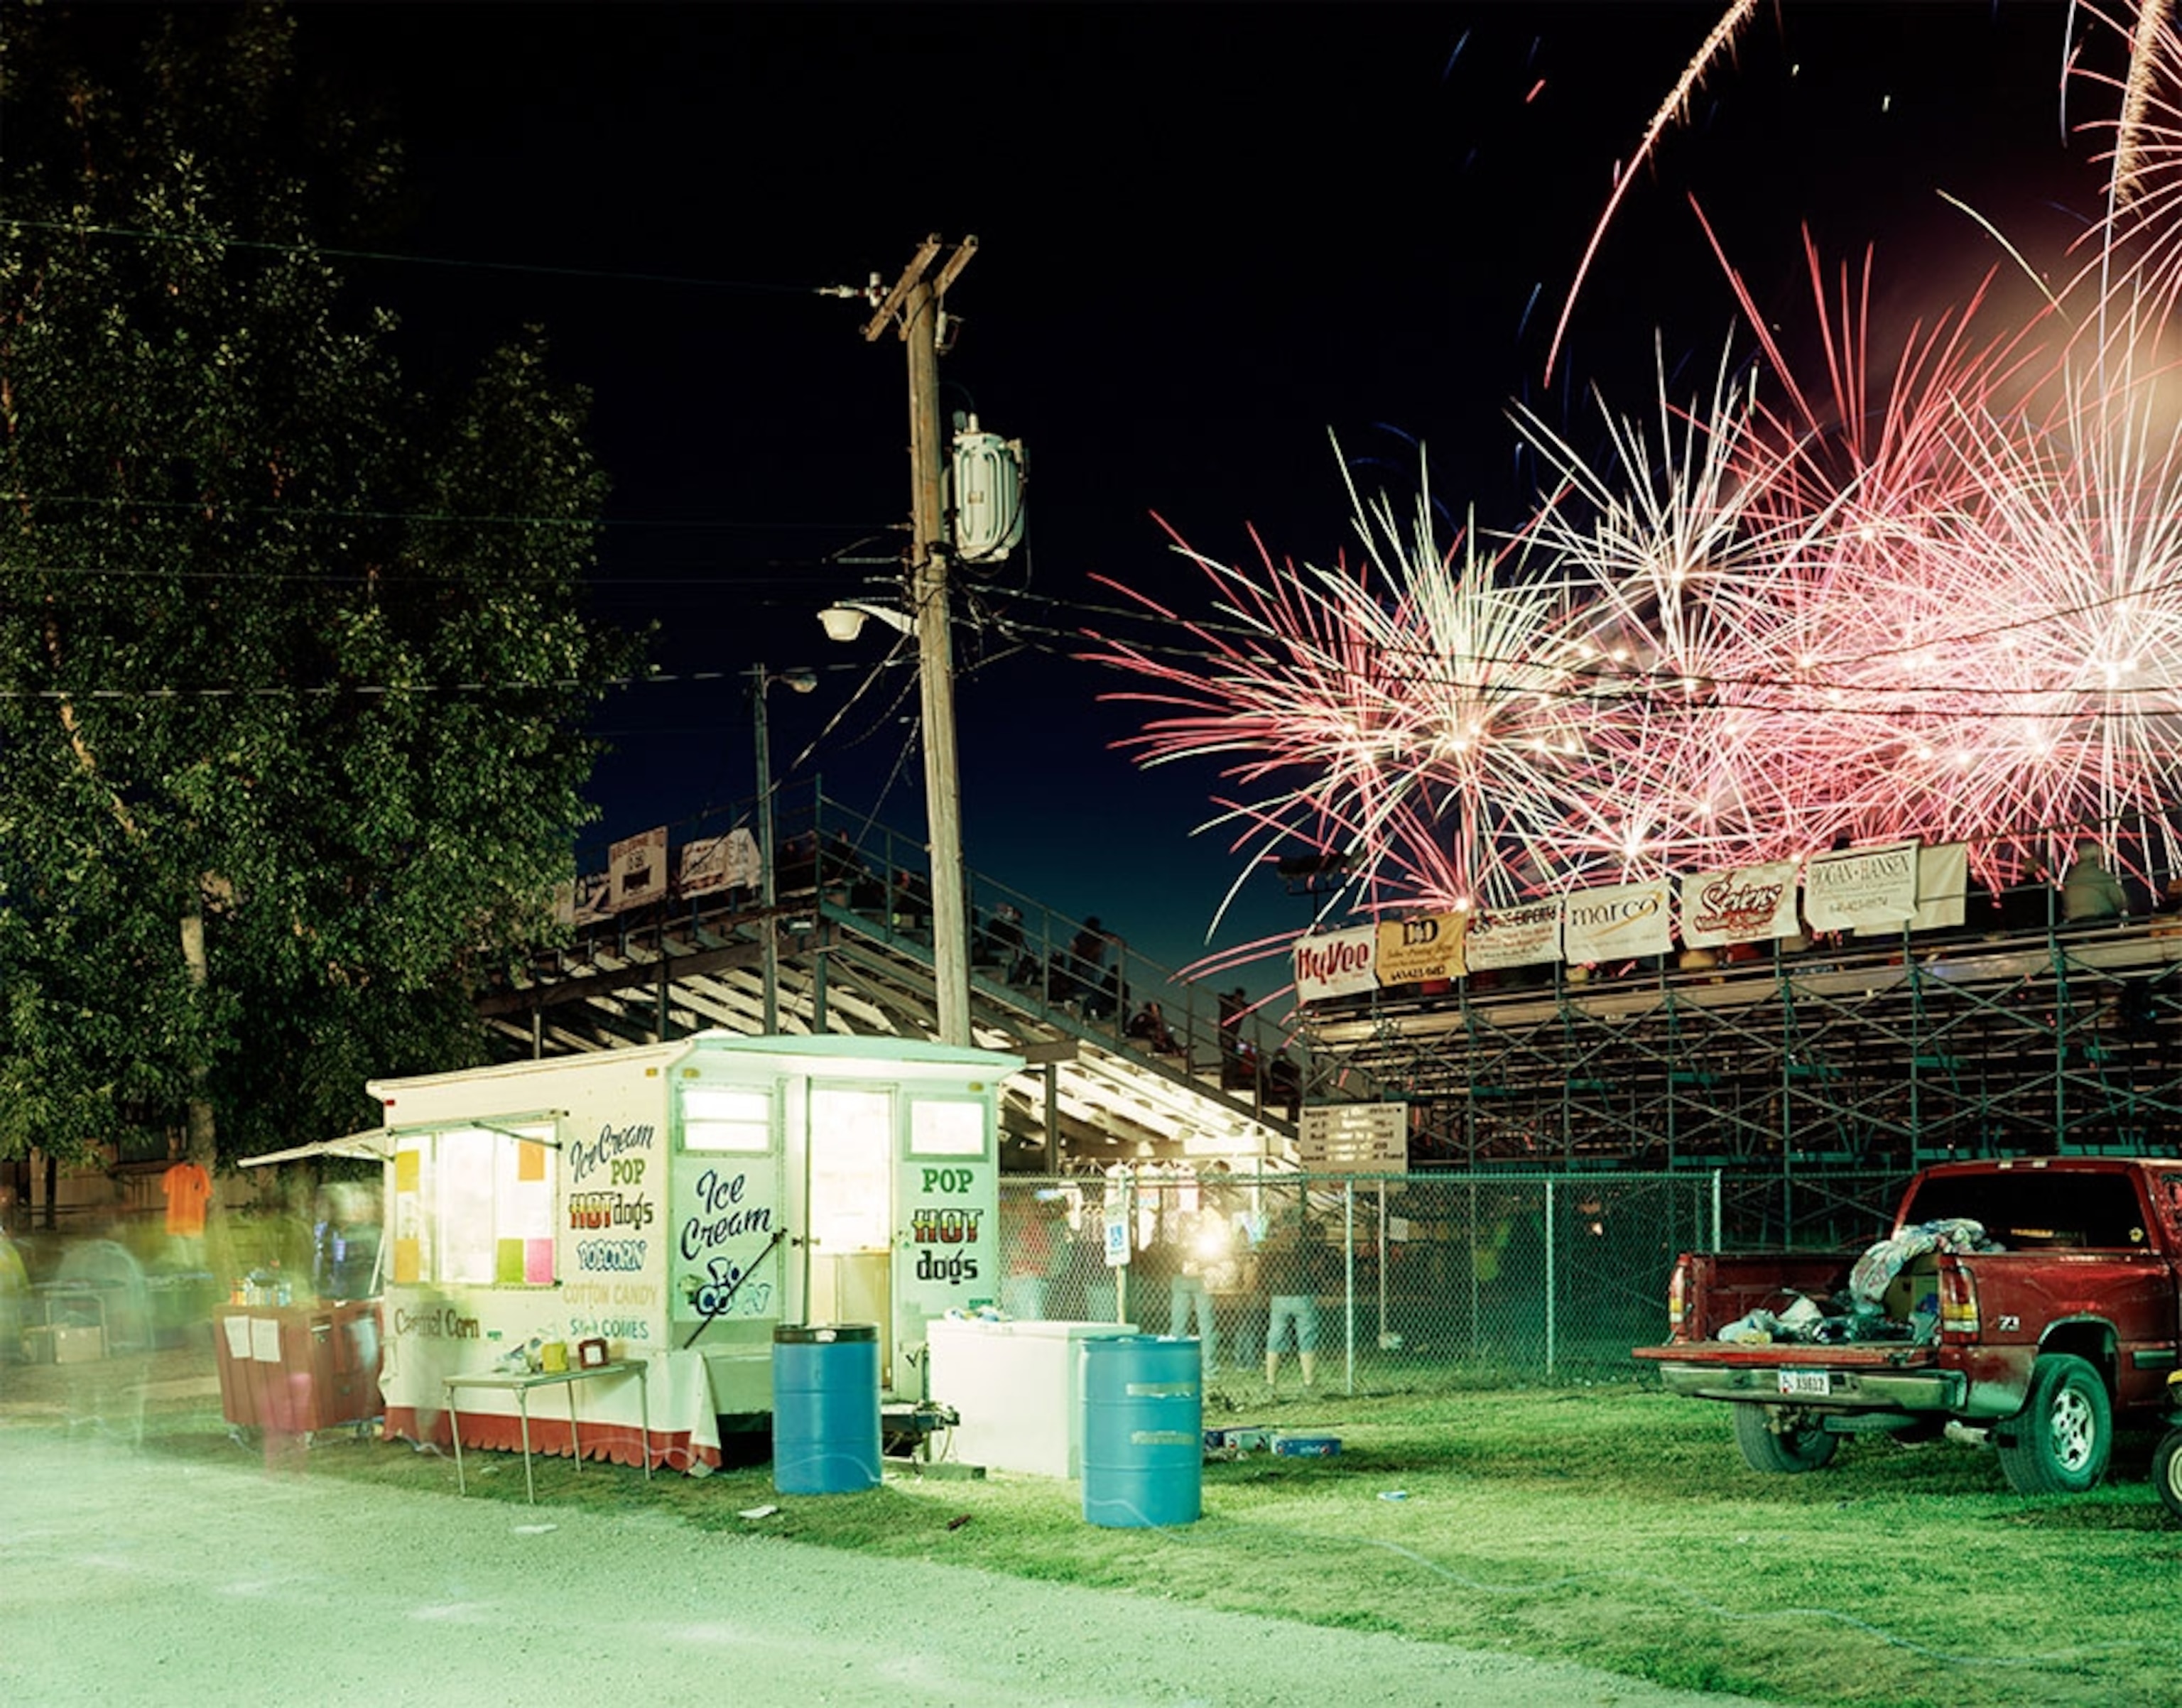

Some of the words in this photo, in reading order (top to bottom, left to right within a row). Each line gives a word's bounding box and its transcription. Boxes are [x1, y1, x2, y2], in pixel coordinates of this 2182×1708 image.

[1571, 898, 1659, 925] marco
[570, 1141, 597, 1184] Ice
[599, 1124, 654, 1163] Cream
[611, 1158, 646, 1185] POP
[922, 1168, 974, 1193] POP
[695, 1170, 745, 1214] Ice
[680, 1207, 772, 1261] Cream
[912, 1208, 984, 1244] HOT
[916, 1249, 978, 1284] dogs
[563, 1283, 609, 1305] COTTON
[614, 1283, 657, 1307] CANDY
[445, 1308, 480, 1339] Corn
